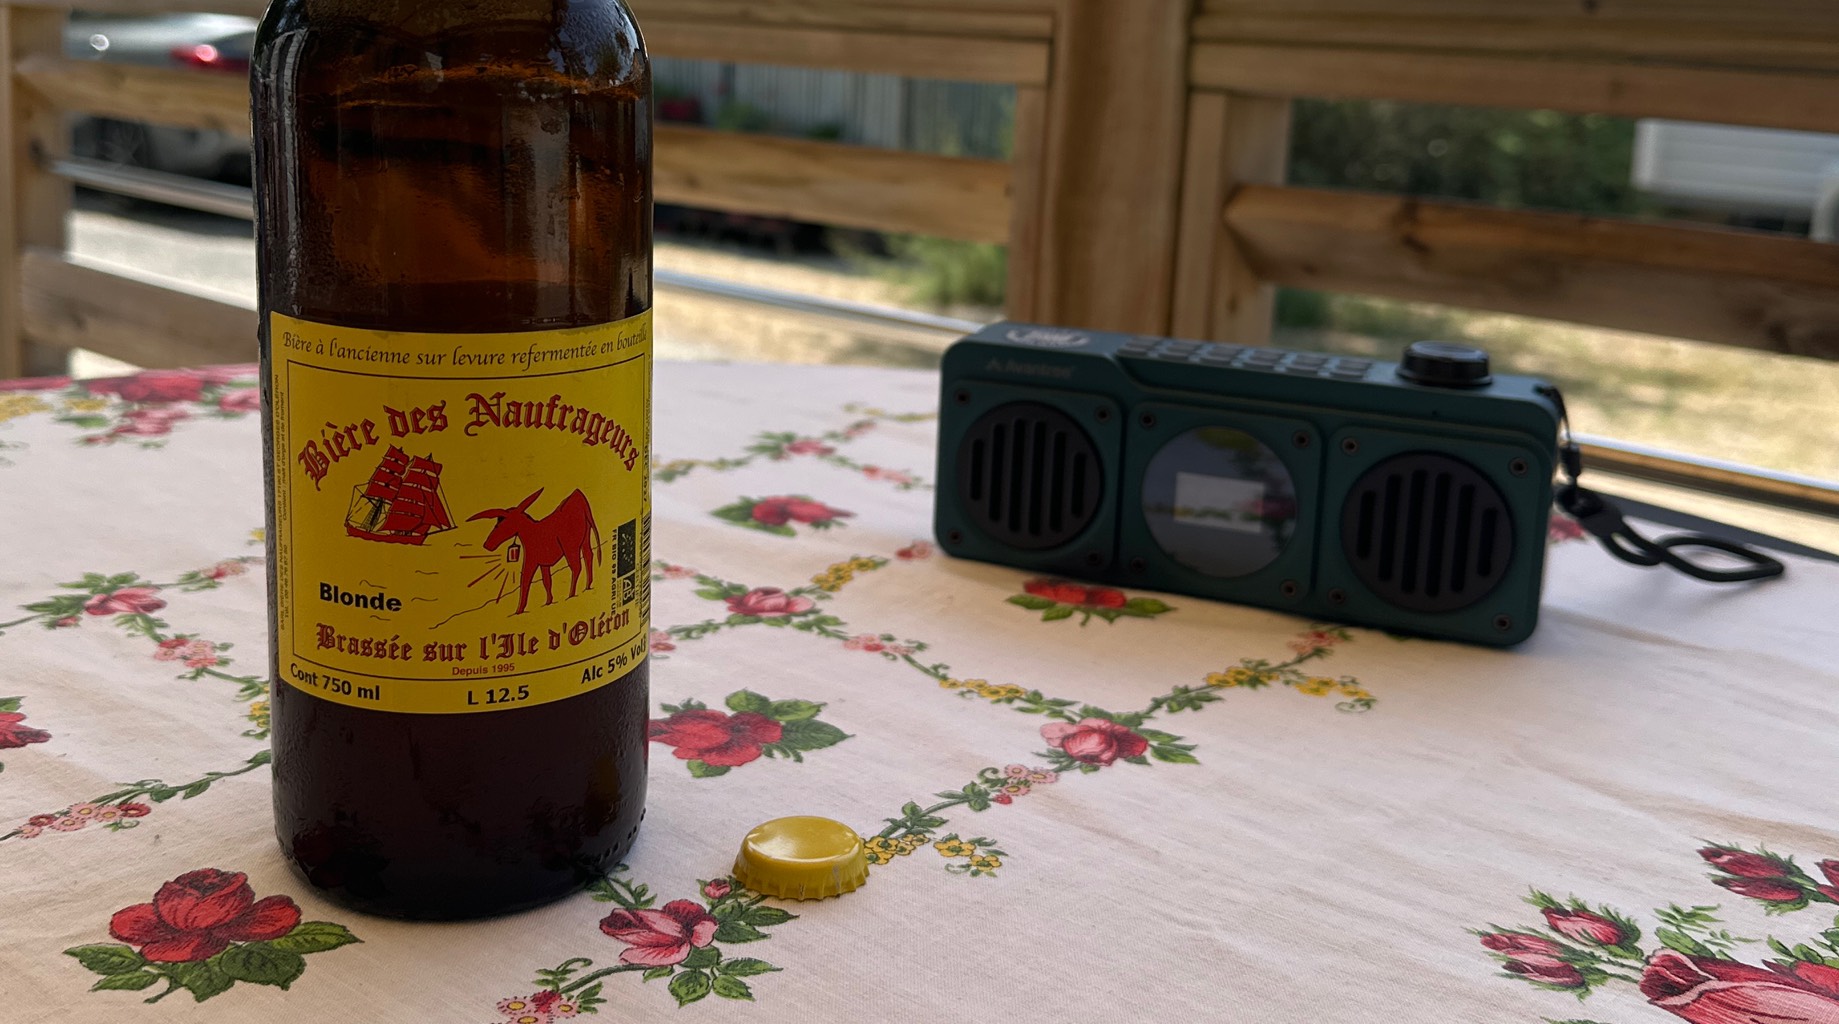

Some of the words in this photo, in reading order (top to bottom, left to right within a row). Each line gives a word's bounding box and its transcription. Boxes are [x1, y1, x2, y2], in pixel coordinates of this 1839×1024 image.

[283, 331, 312, 353] Bière
[315, 338, 324, 356] à
[330, 337, 411, 365] l'ancienne
[416, 352, 447, 366] sur
[452, 345, 506, 366] levure
[510, 341, 598, 372] refermentée
[600, 340, 614, 355] en
[297, 418, 380, 492] Bière
[383, 399, 449, 439] des
[464, 391, 641, 472] Naufrageurs
[319, 581, 402, 612] Blonde
[316, 622, 413, 661] Brassée
[422, 641, 468, 662] sur
[548, 608, 630, 651] d'Oléron
[290, 662, 319, 688] Cont
[322, 674, 352, 696] 750
[357, 684, 380, 701] ml
[452, 665, 489, 677] Depuis
[492, 662, 515, 674] 1995
[581, 665, 604, 685] Alc
[608, 652, 628, 675] 5%
[467, 690, 479, 706] L
[486, 684, 530, 704] 12.5
